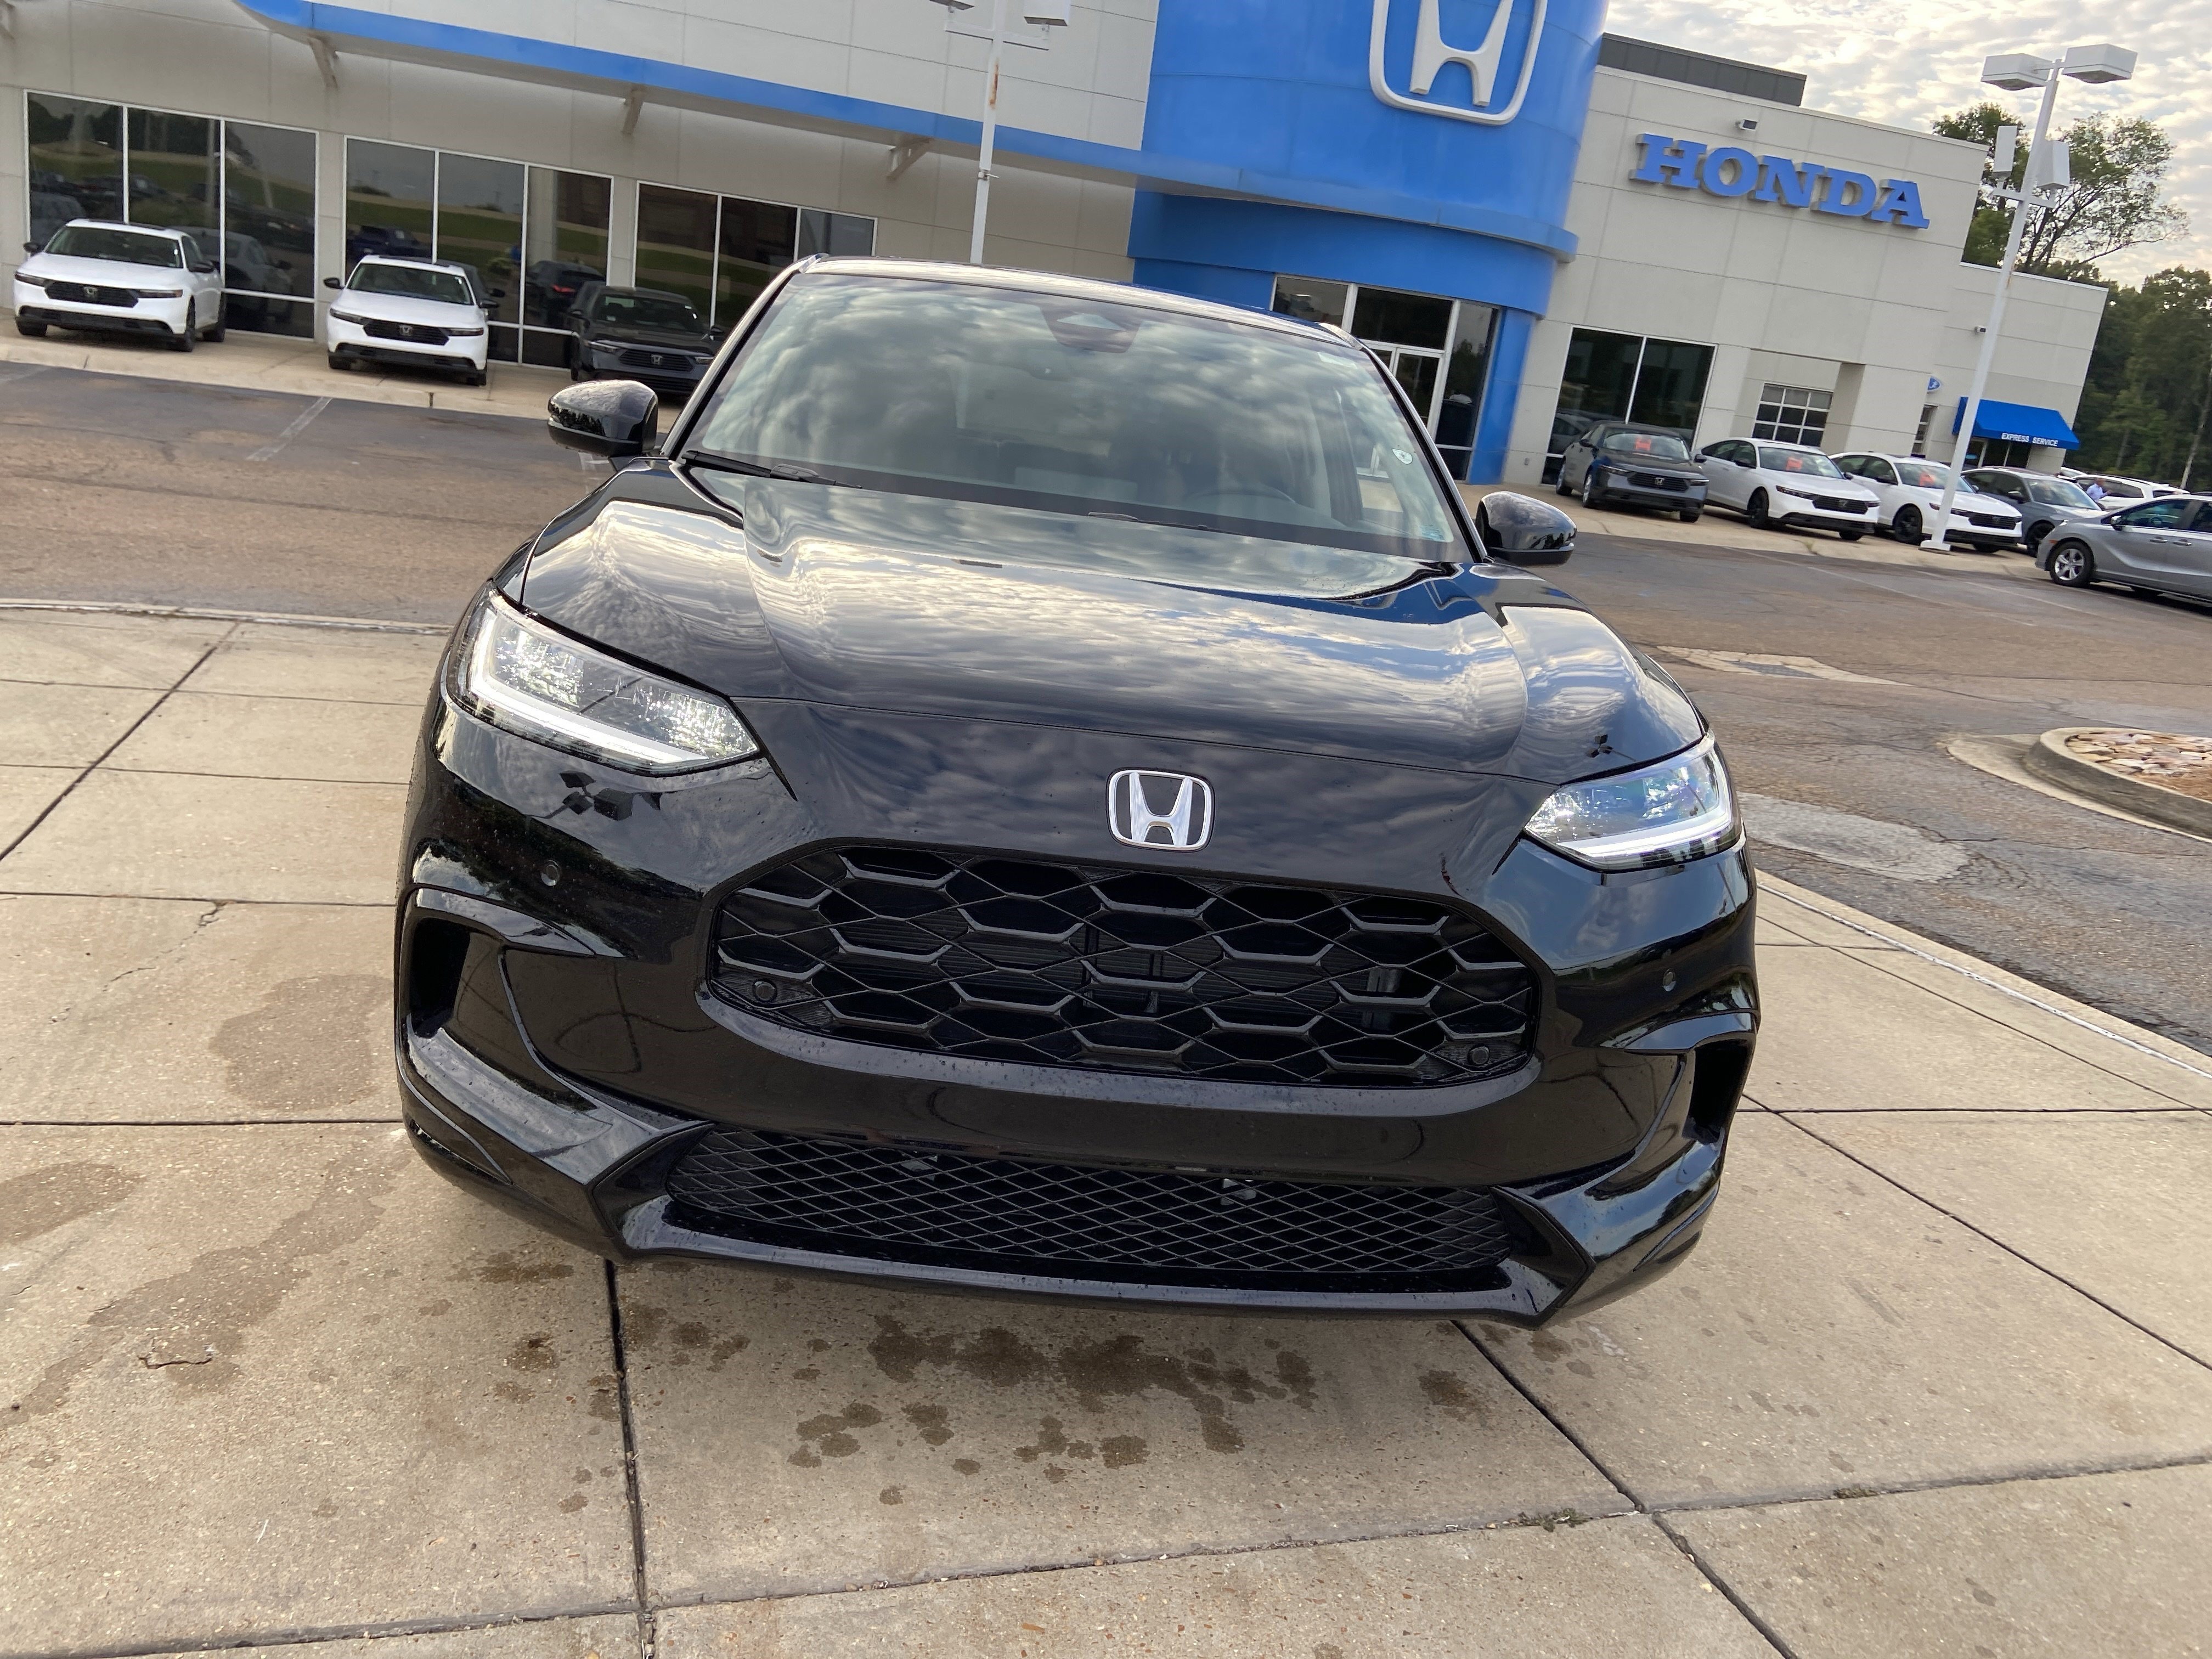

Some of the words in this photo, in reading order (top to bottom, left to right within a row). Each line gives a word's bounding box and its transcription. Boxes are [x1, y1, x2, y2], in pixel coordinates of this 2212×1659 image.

[1629, 133, 1929, 229] HONDA
[2001, 432, 2029, 442] EXPRESS
[2033, 437, 2058, 447] SERVICE
